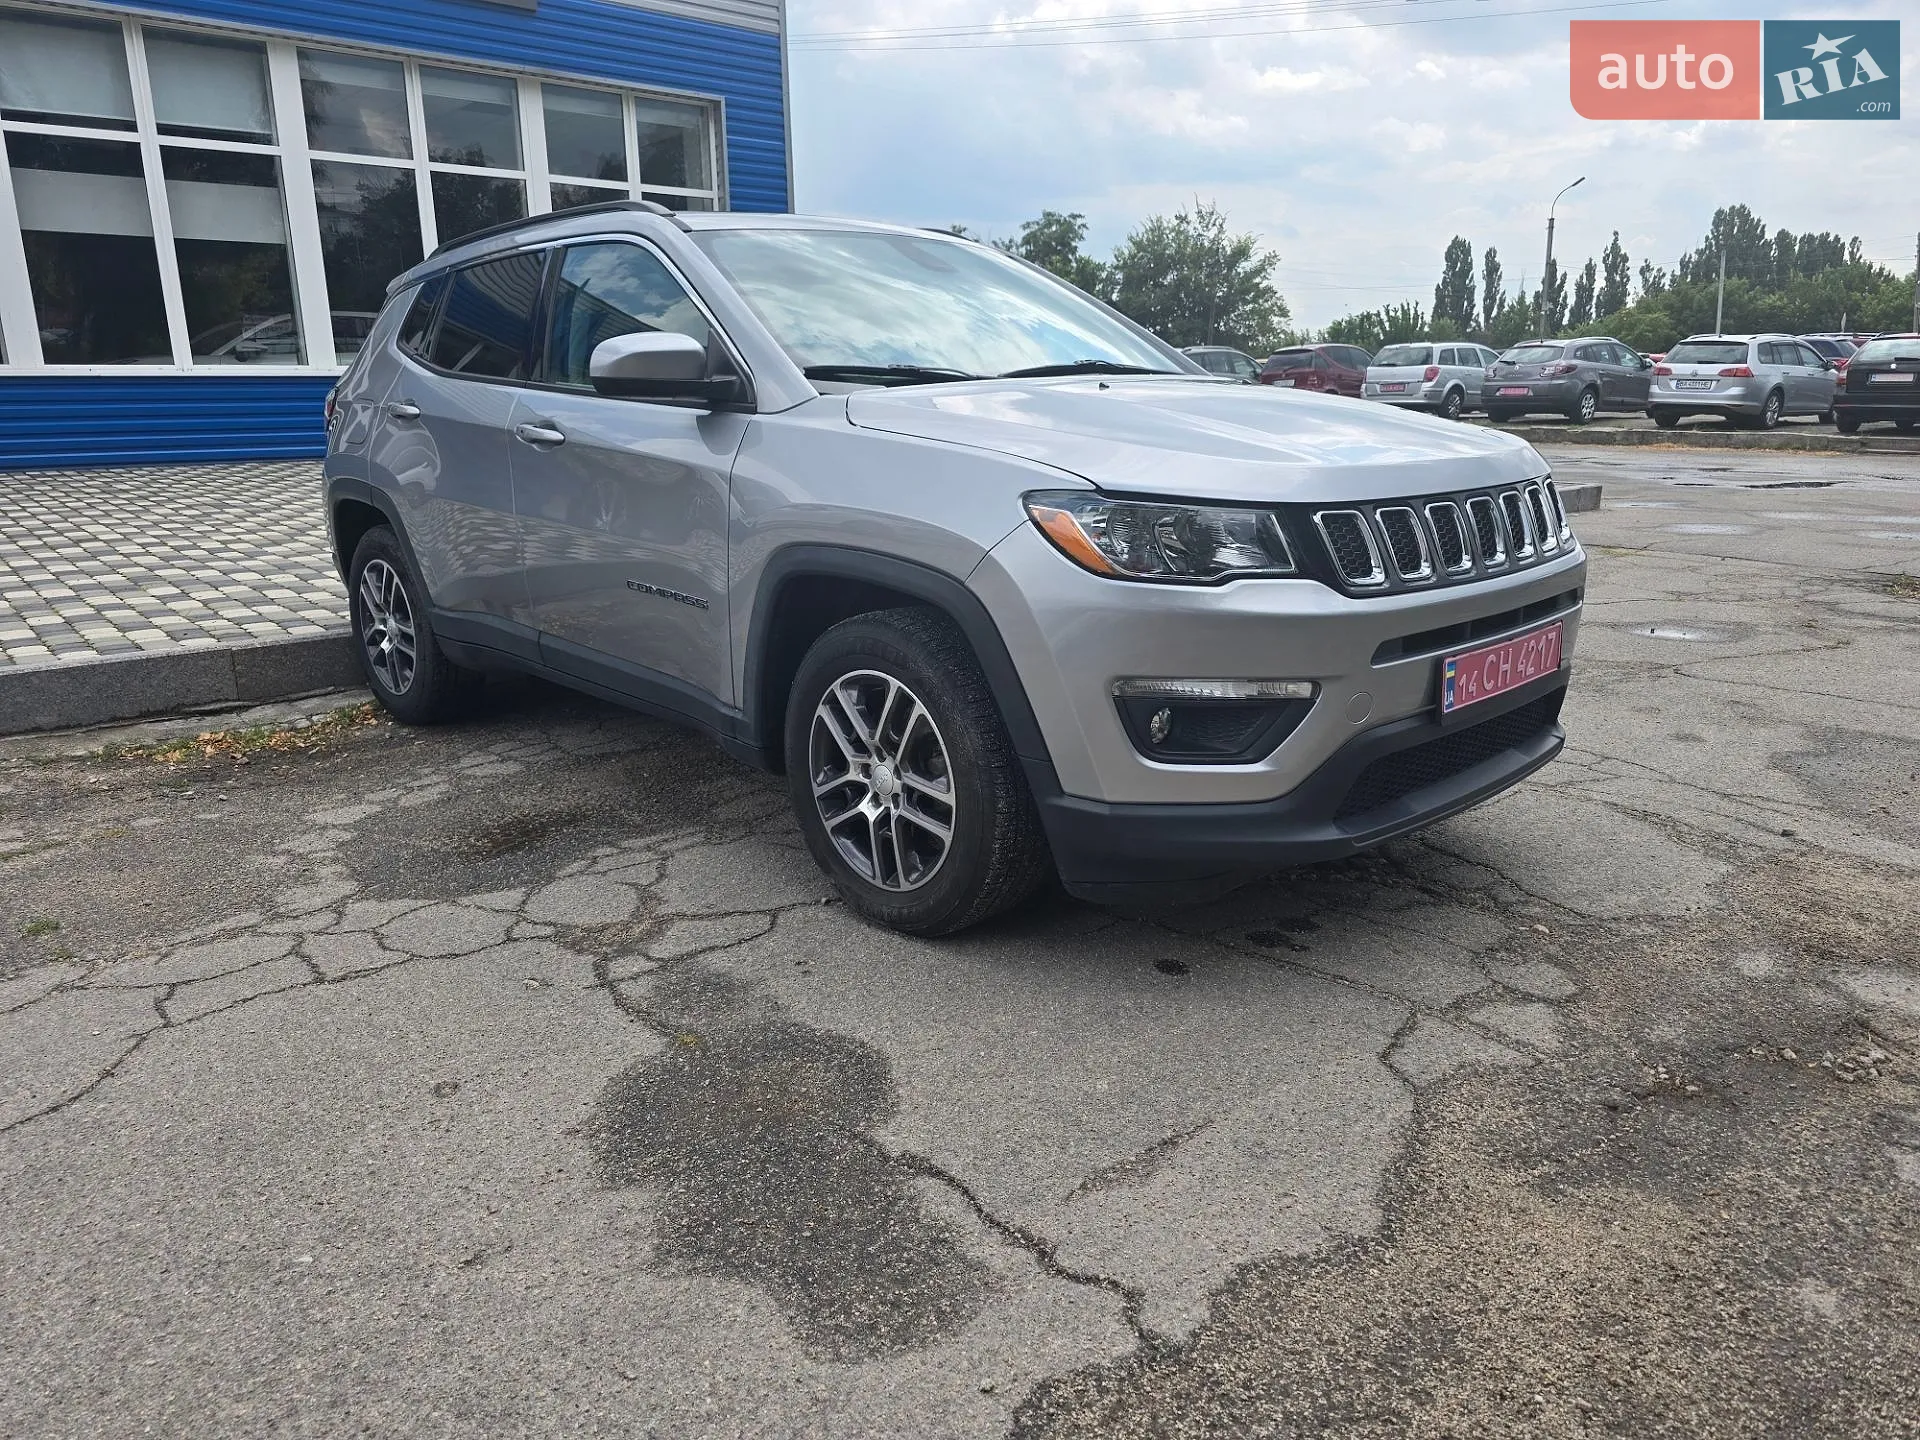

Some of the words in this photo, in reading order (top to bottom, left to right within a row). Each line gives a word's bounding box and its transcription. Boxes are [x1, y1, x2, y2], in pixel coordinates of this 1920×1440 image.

[627, 579, 709, 609] COMPASS
[1459, 670, 1478, 700] 14
[1483, 648, 1512, 690] CH
[1518, 632, 1556, 677] 4217
